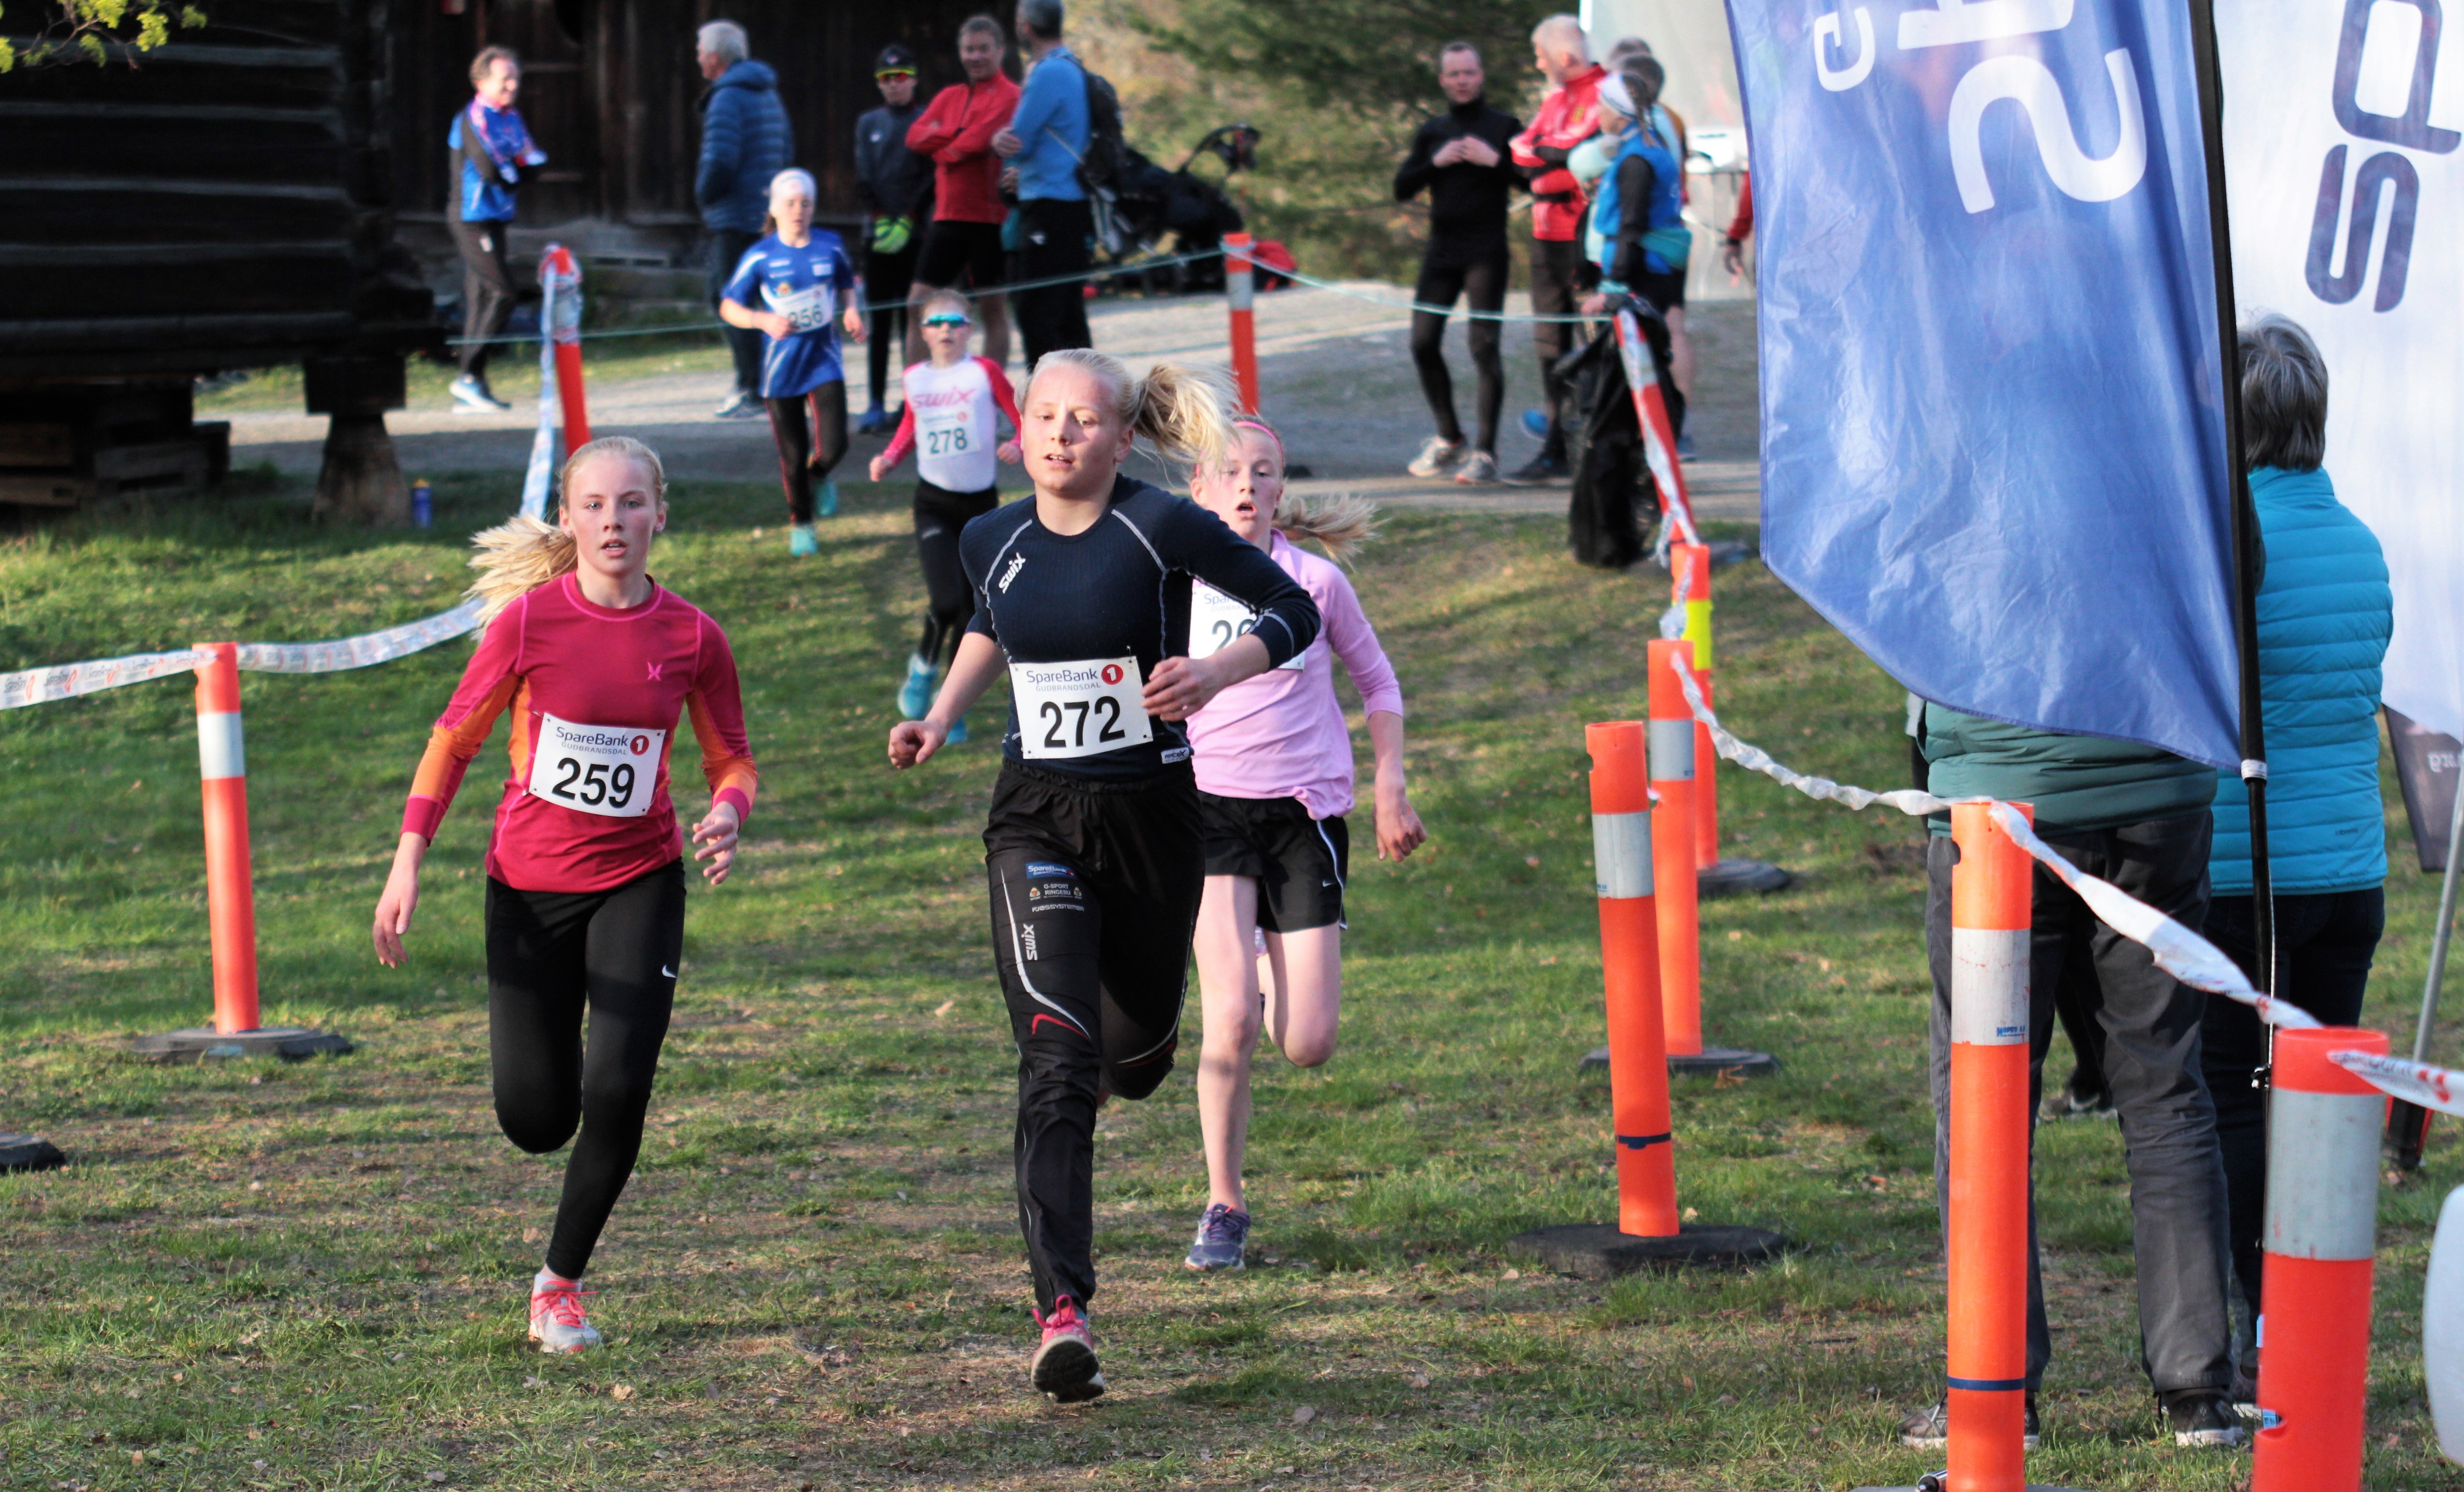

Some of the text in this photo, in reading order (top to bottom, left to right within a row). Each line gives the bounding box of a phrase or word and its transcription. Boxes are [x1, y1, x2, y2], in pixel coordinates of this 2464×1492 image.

[928, 427, 967, 454] 278
[1026, 668, 1098, 685] SpareBank
[1036, 682, 1101, 692] GUDBRANDSDAL
[1040, 696, 1125, 748] 272
[556, 727, 628, 747] SpareBank
[561, 742, 627, 755] GUDBRANDSDAL
[551, 757, 635, 809] 259
